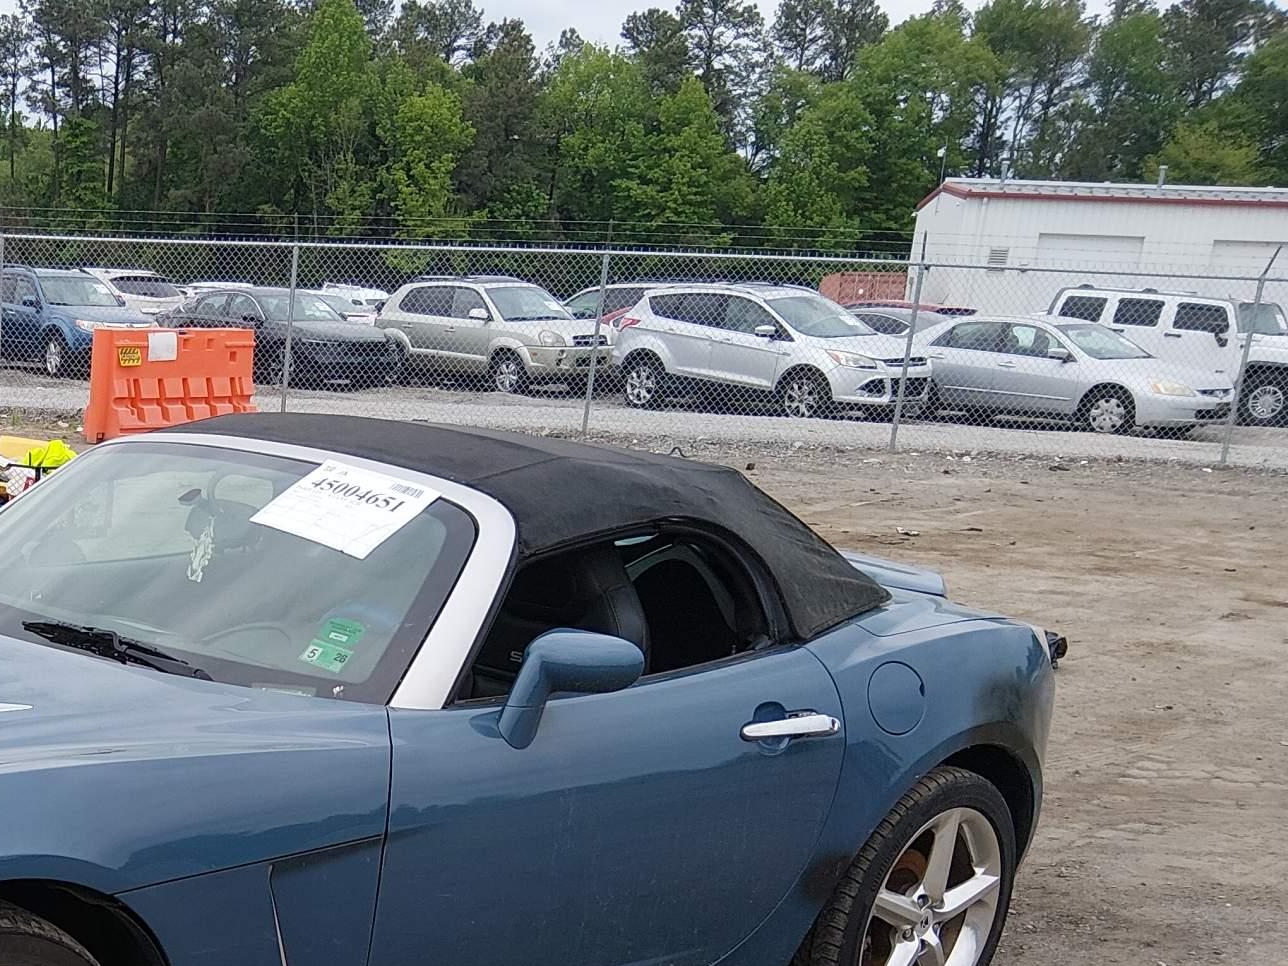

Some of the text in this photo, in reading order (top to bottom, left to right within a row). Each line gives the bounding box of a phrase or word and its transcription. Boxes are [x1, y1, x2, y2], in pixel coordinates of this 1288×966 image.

[311, 478, 405, 512] 45004651
[307, 648, 348, 663] 5 26
